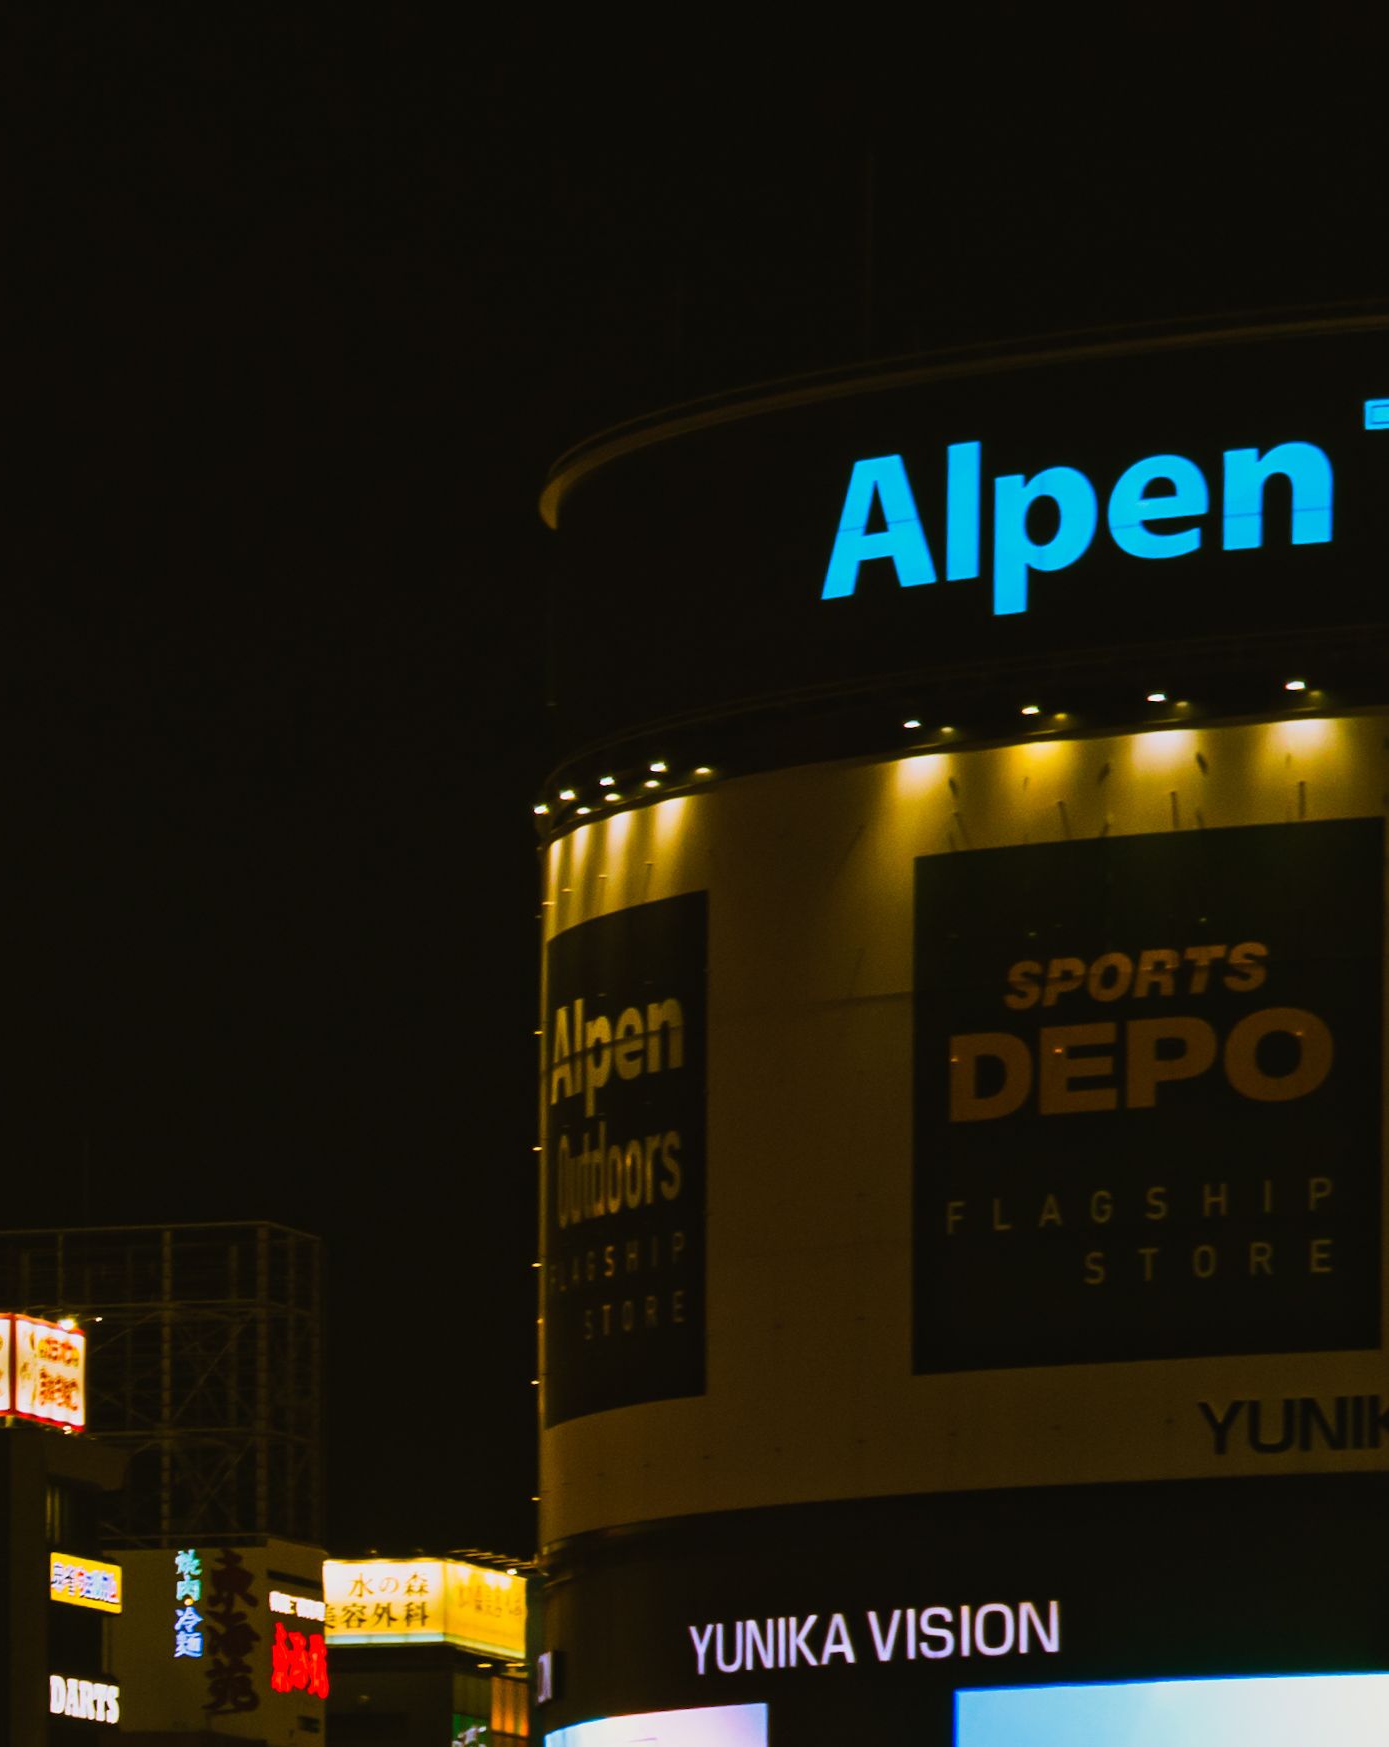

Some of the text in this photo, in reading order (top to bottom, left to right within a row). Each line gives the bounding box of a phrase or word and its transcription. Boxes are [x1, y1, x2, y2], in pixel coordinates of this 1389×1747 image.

[821, 441, 1333, 616] Alpen
[1004, 941, 1270, 1010] SPORTS
[551, 994, 684, 1117] Alpen
[948, 1007, 1334, 1123] DEPO
[556, 1129, 682, 1230] Outdoors
[946, 1177, 1333, 1235] FLAGSHIP
[1085, 1240, 1333, 1286] STORE
[583, 1291, 684, 1341] STORE
[347, 1571, 430, 1599] 水の森
[689, 1601, 1061, 1675] YUNIKA VISION
[50, 1674, 119, 1724] DARTS
